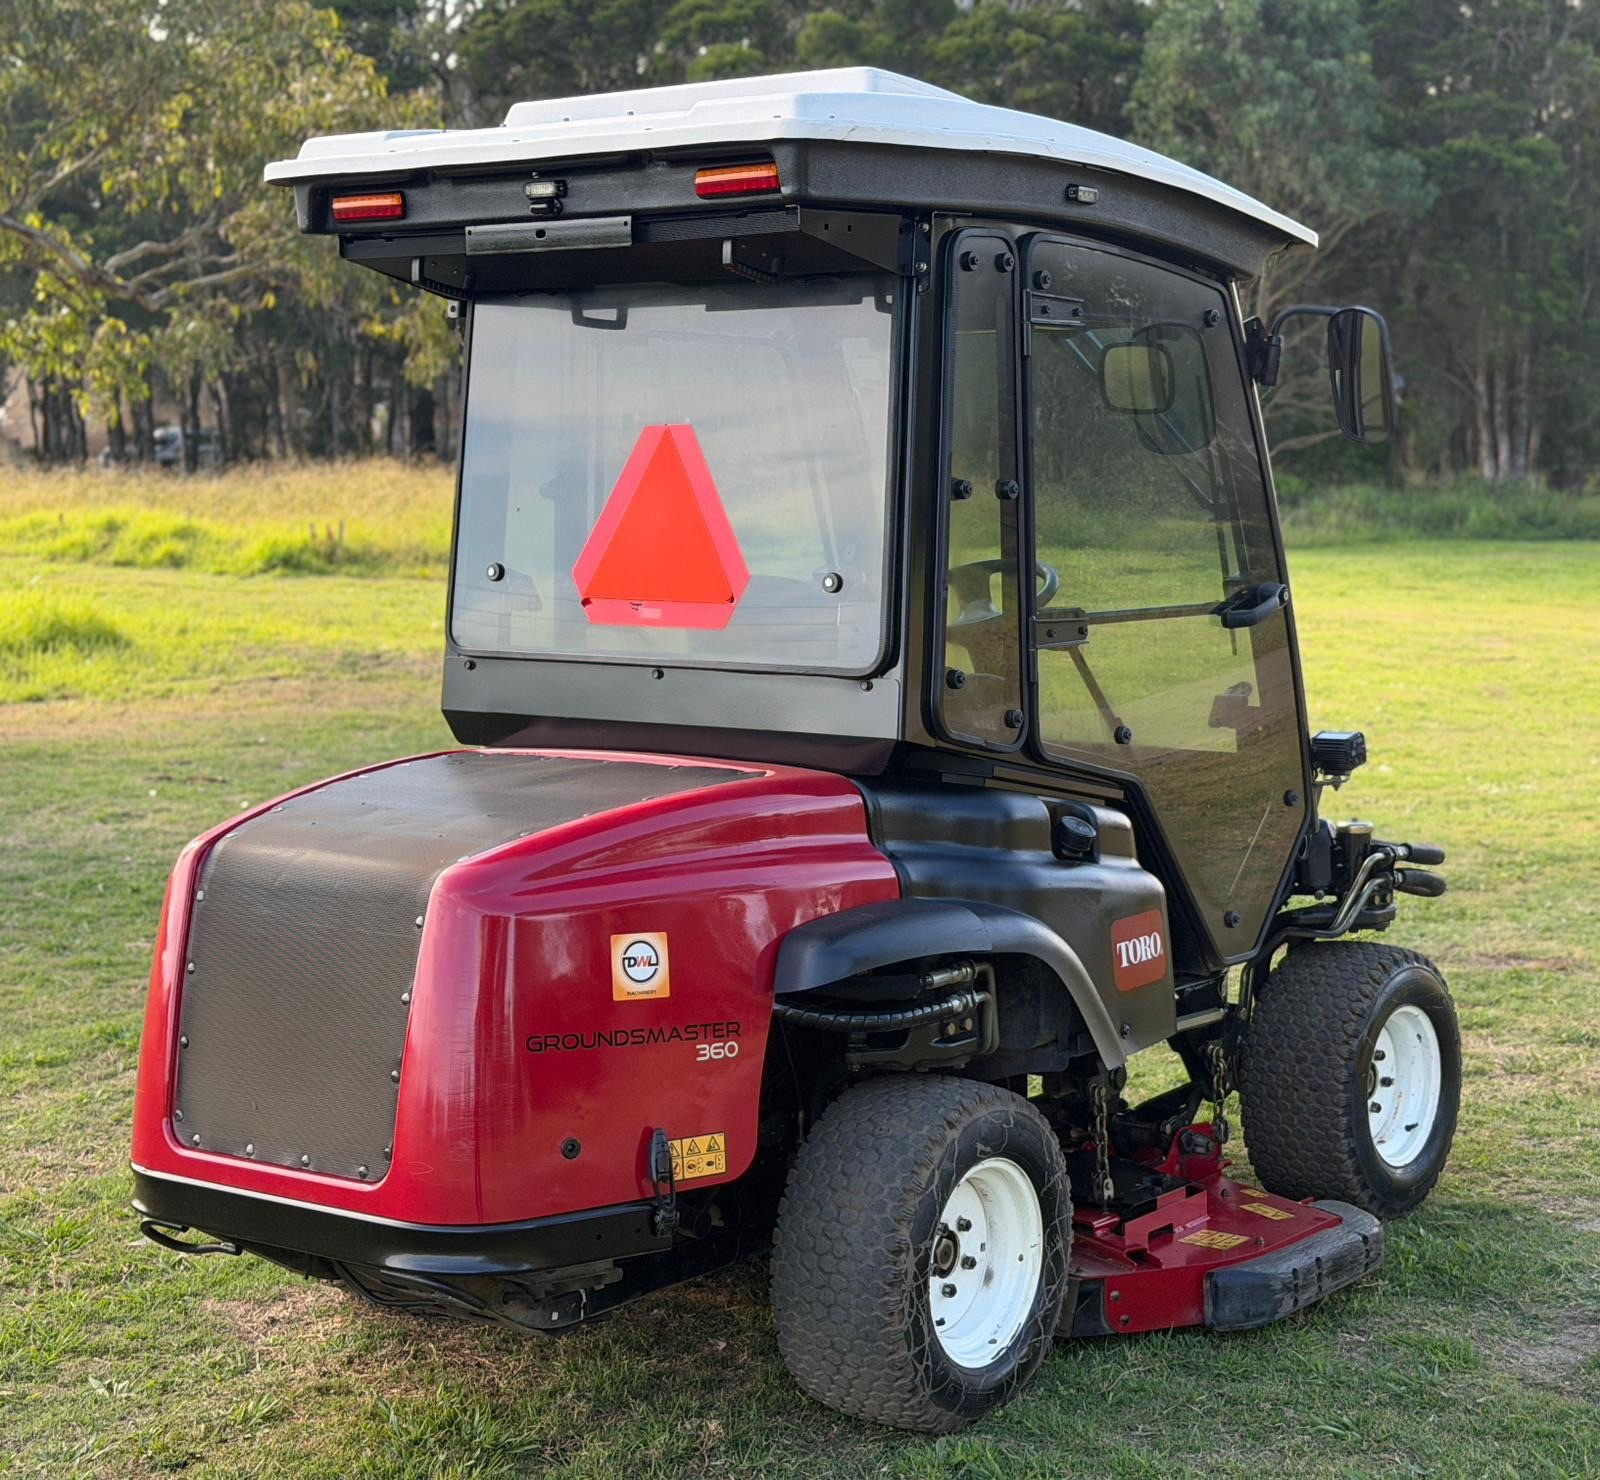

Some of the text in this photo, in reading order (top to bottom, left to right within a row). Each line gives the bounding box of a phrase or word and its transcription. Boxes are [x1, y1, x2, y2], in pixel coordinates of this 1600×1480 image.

[623, 955, 658, 968] DWL
[527, 1022, 742, 1053] GROUNDSMASTER
[695, 1041, 739, 1062] 360
